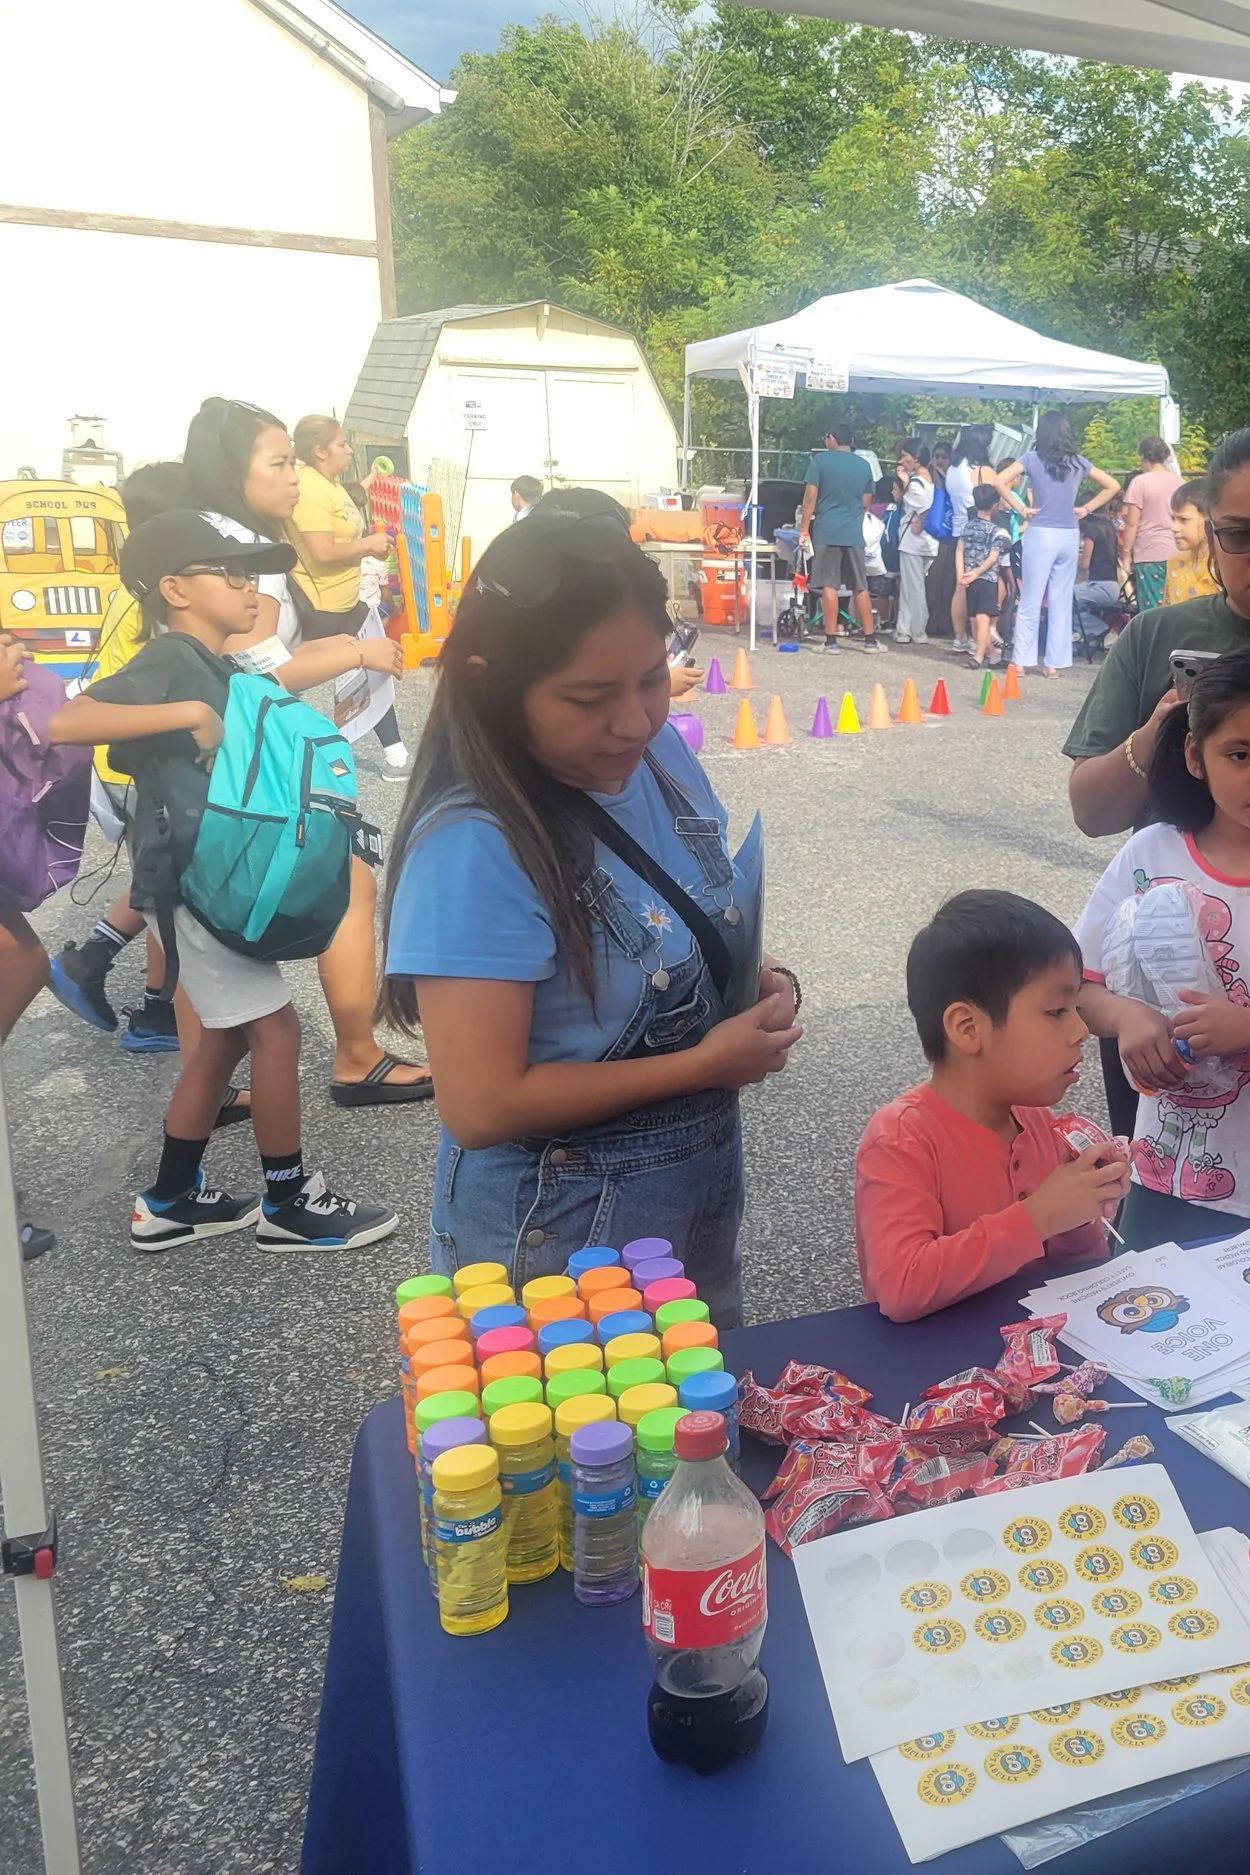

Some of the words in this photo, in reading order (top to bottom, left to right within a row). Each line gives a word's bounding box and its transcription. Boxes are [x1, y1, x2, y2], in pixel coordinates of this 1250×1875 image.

[26, 501, 69, 509] SCHOOL
[75, 501, 97, 509] BUS
[266, 1164, 302, 1181] NIKE
[1150, 1317, 1227, 1355] VOICE
[1181, 1333, 1233, 1362] ONE
[740, 1410, 782, 1433] Ring
[1059, 1508, 1071, 1530] BUDDY
[1113, 1499, 1125, 1520] BUDDY
[455, 1517, 497, 1537] bubble
[1004, 1521, 1017, 1543] BUDDY
[1075, 1549, 1088, 1571] BUDDY
[1131, 1540, 1143, 1561] BUDDY
[1020, 1564, 1032, 1583] BUDDY
[1035, 1602, 1048, 1621] BUDDY
[916, 1623, 929, 1643] BUDDY
[1235, 1681, 1246, 1692] NOT
[1177, 1699, 1190, 1712] NOT
[1212, 1700, 1225, 1720] BUDDY
[1116, 1718, 1129, 1730] NOT
[1153, 1720, 1166, 1739] BUDDY
[1181, 1715, 1207, 1725] BULLY
[970, 1725, 998, 1738] BULLY
[1053, 1734, 1069, 1748] NOT
[1120, 1735, 1145, 1746] BULLY
[906, 1748, 932, 1758] BULLY
[989, 1750, 1004, 1764] NOT
[1057, 1752, 1083, 1764] BULLY
[1093, 1738, 1105, 1759] BUDDY
[992, 1768, 1019, 1781] BULLY
[1028, 1754, 1041, 1776] BUDDY
[923, 1769, 938, 1785] NOT
[962, 1772, 976, 1798] BUDDY
[925, 1790, 952, 1803] BULLY
